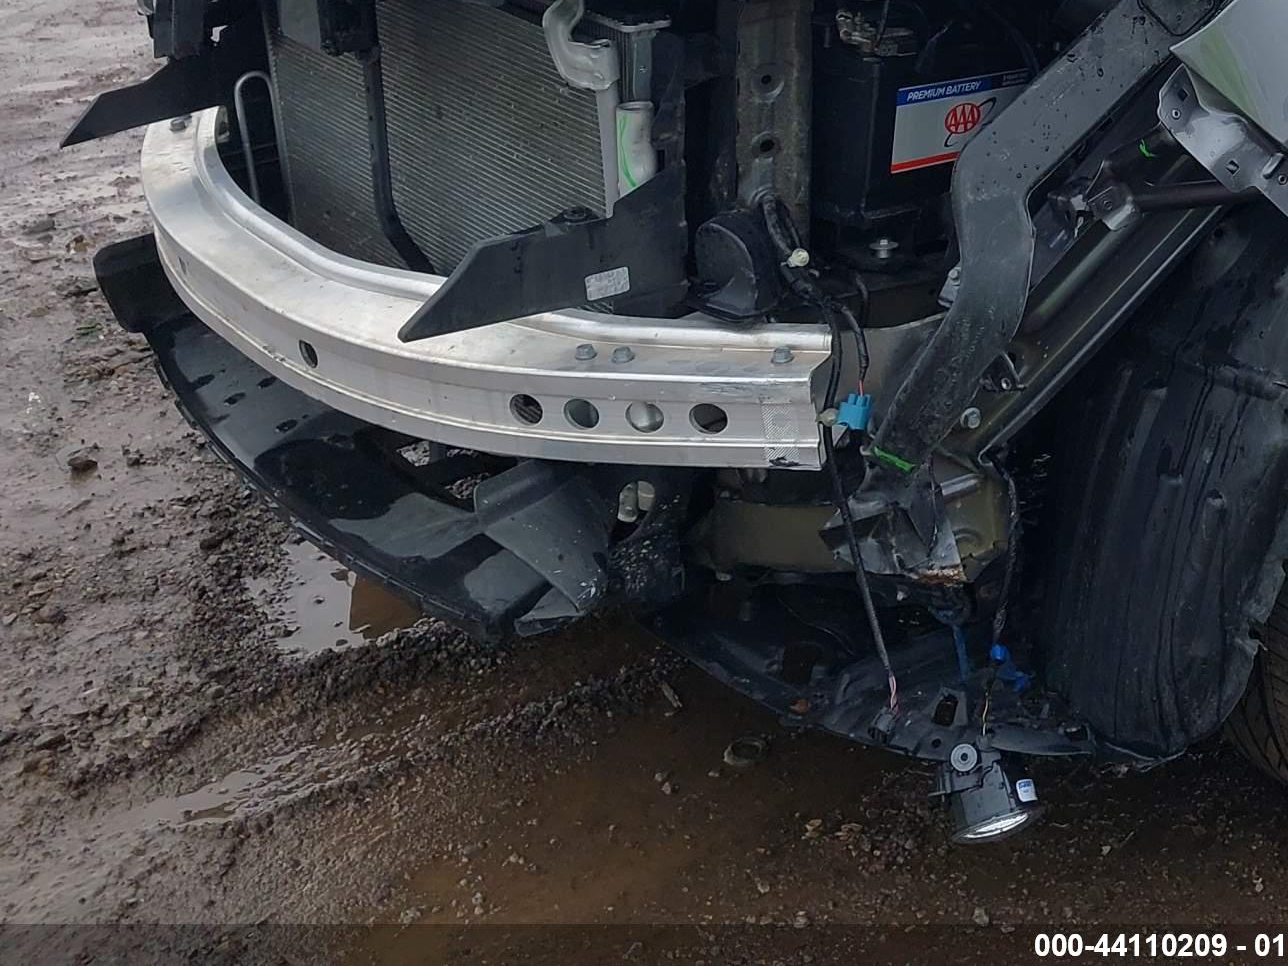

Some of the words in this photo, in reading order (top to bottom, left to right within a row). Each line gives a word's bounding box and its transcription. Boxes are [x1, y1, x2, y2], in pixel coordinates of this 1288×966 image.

[907, 87, 946, 101] PREMIUM
[947, 81, 982, 94] BATTERY
[946, 104, 979, 133] AAA
